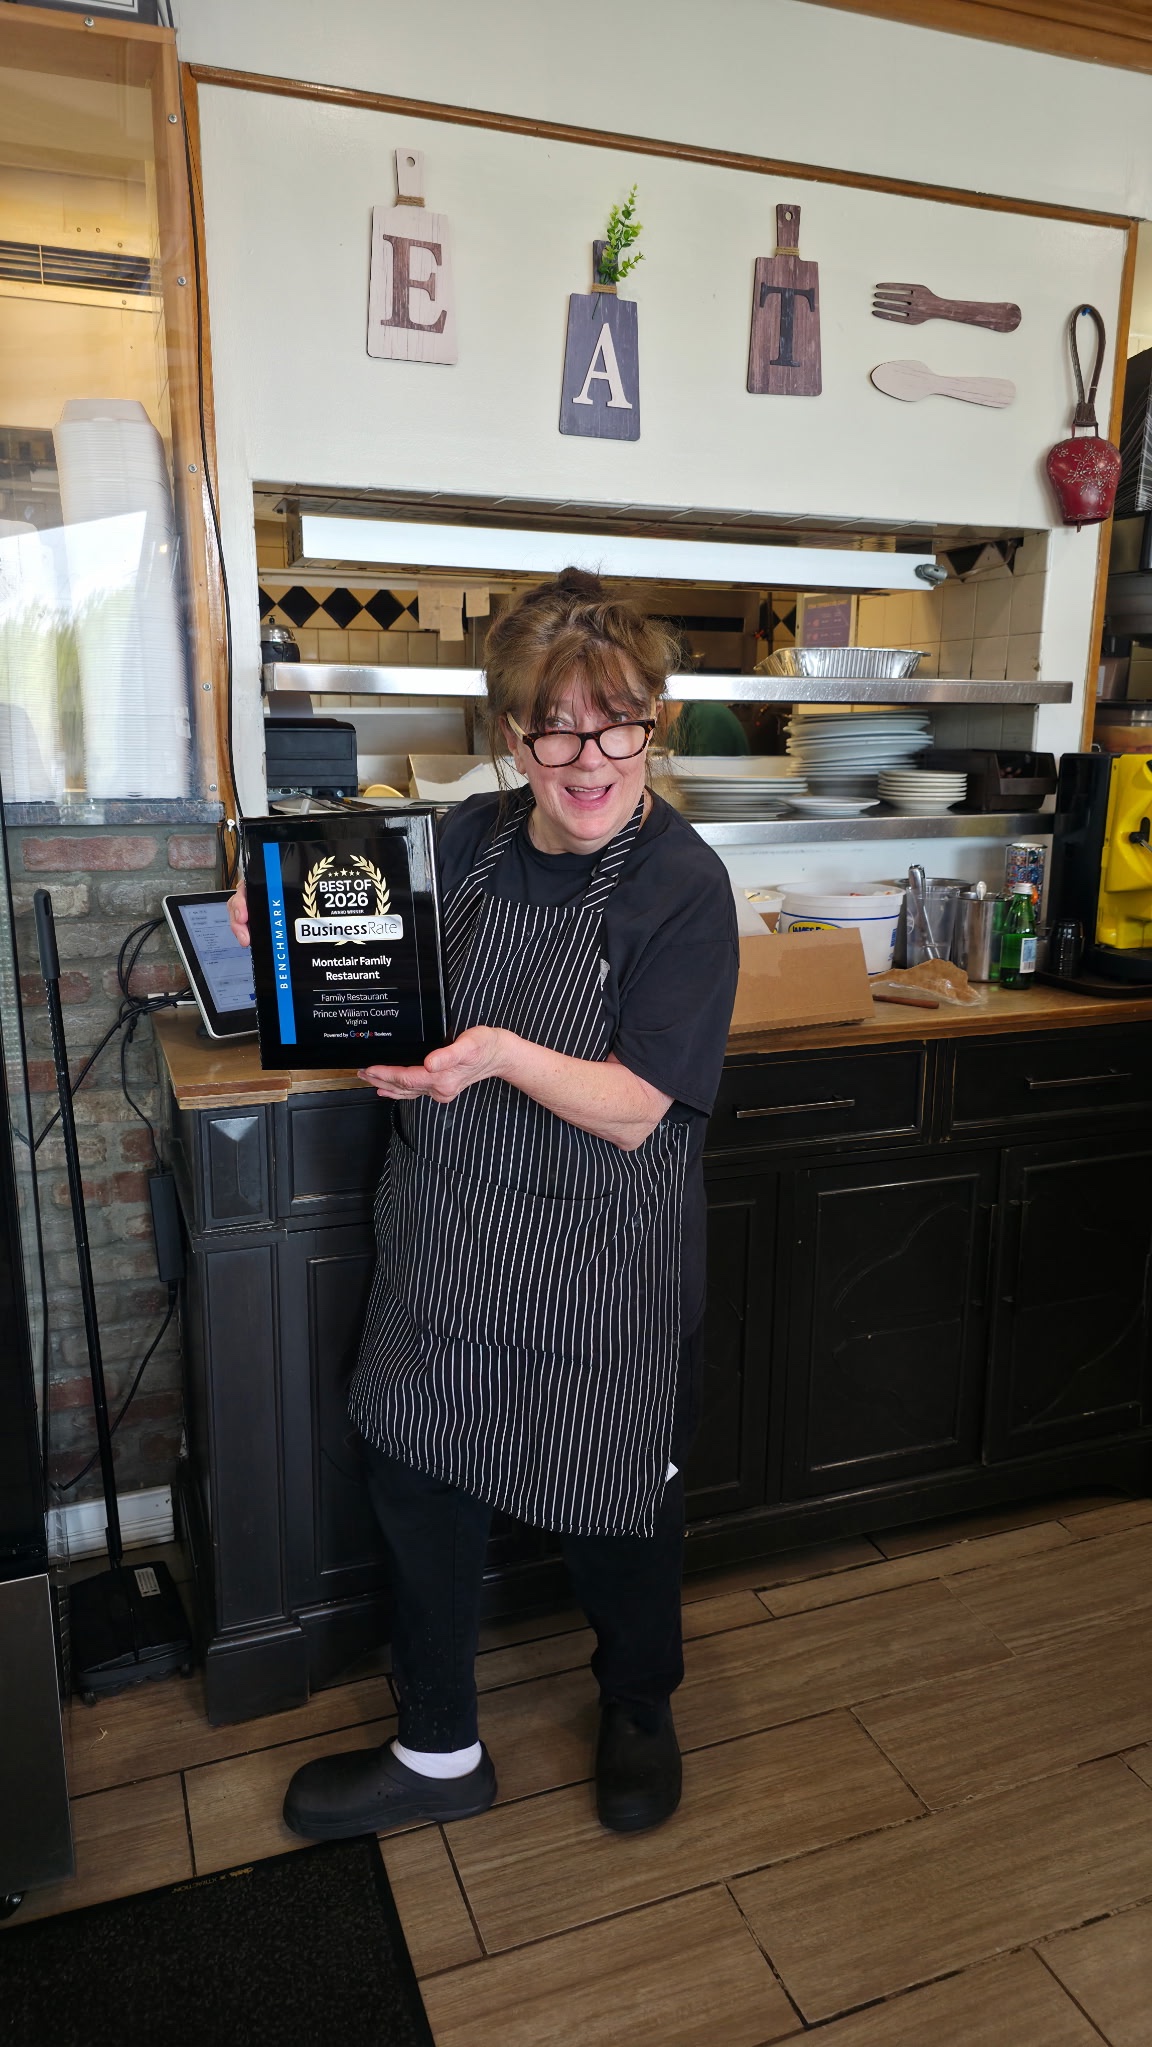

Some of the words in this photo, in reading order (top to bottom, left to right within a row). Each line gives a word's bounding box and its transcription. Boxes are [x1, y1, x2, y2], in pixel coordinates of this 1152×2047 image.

[380, 233, 447, 334] E
[759, 281, 816, 367] T
[571, 322, 633, 410] A
[319, 880, 352, 892] BEST
[353, 879, 372, 891] OF
[323, 892, 369, 908] 2026
[301, 921, 398, 937] BusinessRate
[272, 899, 289, 989] BENCHMARK
[312, 956, 358, 967] Montclair
[359, 955, 392, 967] Family
[325, 970, 381, 981] Restaurant
[321, 994, 345, 1003] Family
[346, 993, 388, 1001] Restaurant
[313, 1009, 338, 1018] Prince
[338, 1009, 369, 1017] William
[370, 1008, 399, 1018] County
[345, 1018, 368, 1026] Virginia
[349, 1030, 373, 1039] Google
